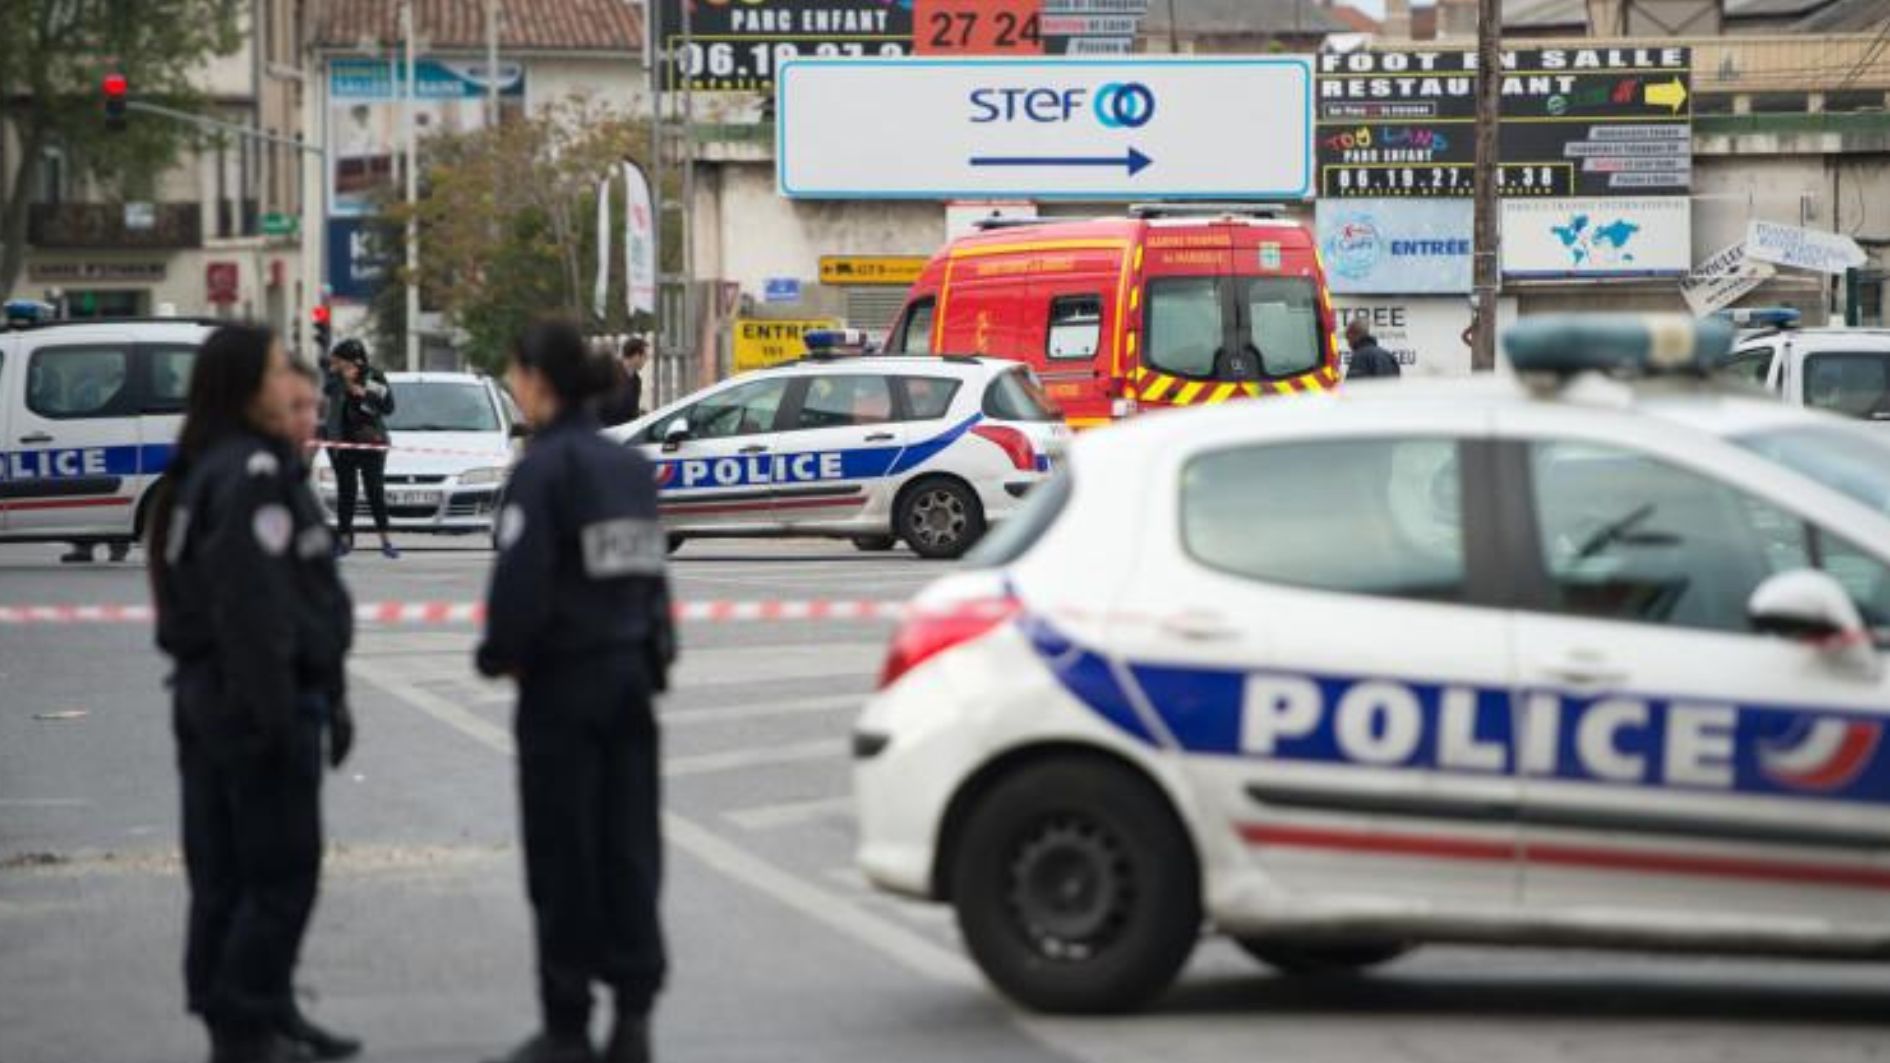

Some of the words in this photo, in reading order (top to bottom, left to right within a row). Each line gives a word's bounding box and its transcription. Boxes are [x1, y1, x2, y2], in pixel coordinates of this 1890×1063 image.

[731, 8, 791, 31] PARC
[802, 9, 887, 31] ENFANT
[929, 12, 977, 46] 27
[994, 10, 1041, 47] 24
[1322, 53, 1439, 72] FOOT
[1543, 49, 1683, 68] SALLE
[1321, 76, 1577, 98] RESTAUANT
[0, 450, 107, 479] LICE
[682, 452, 842, 486] POLICE
[1239, 671, 1739, 788] POLICE
